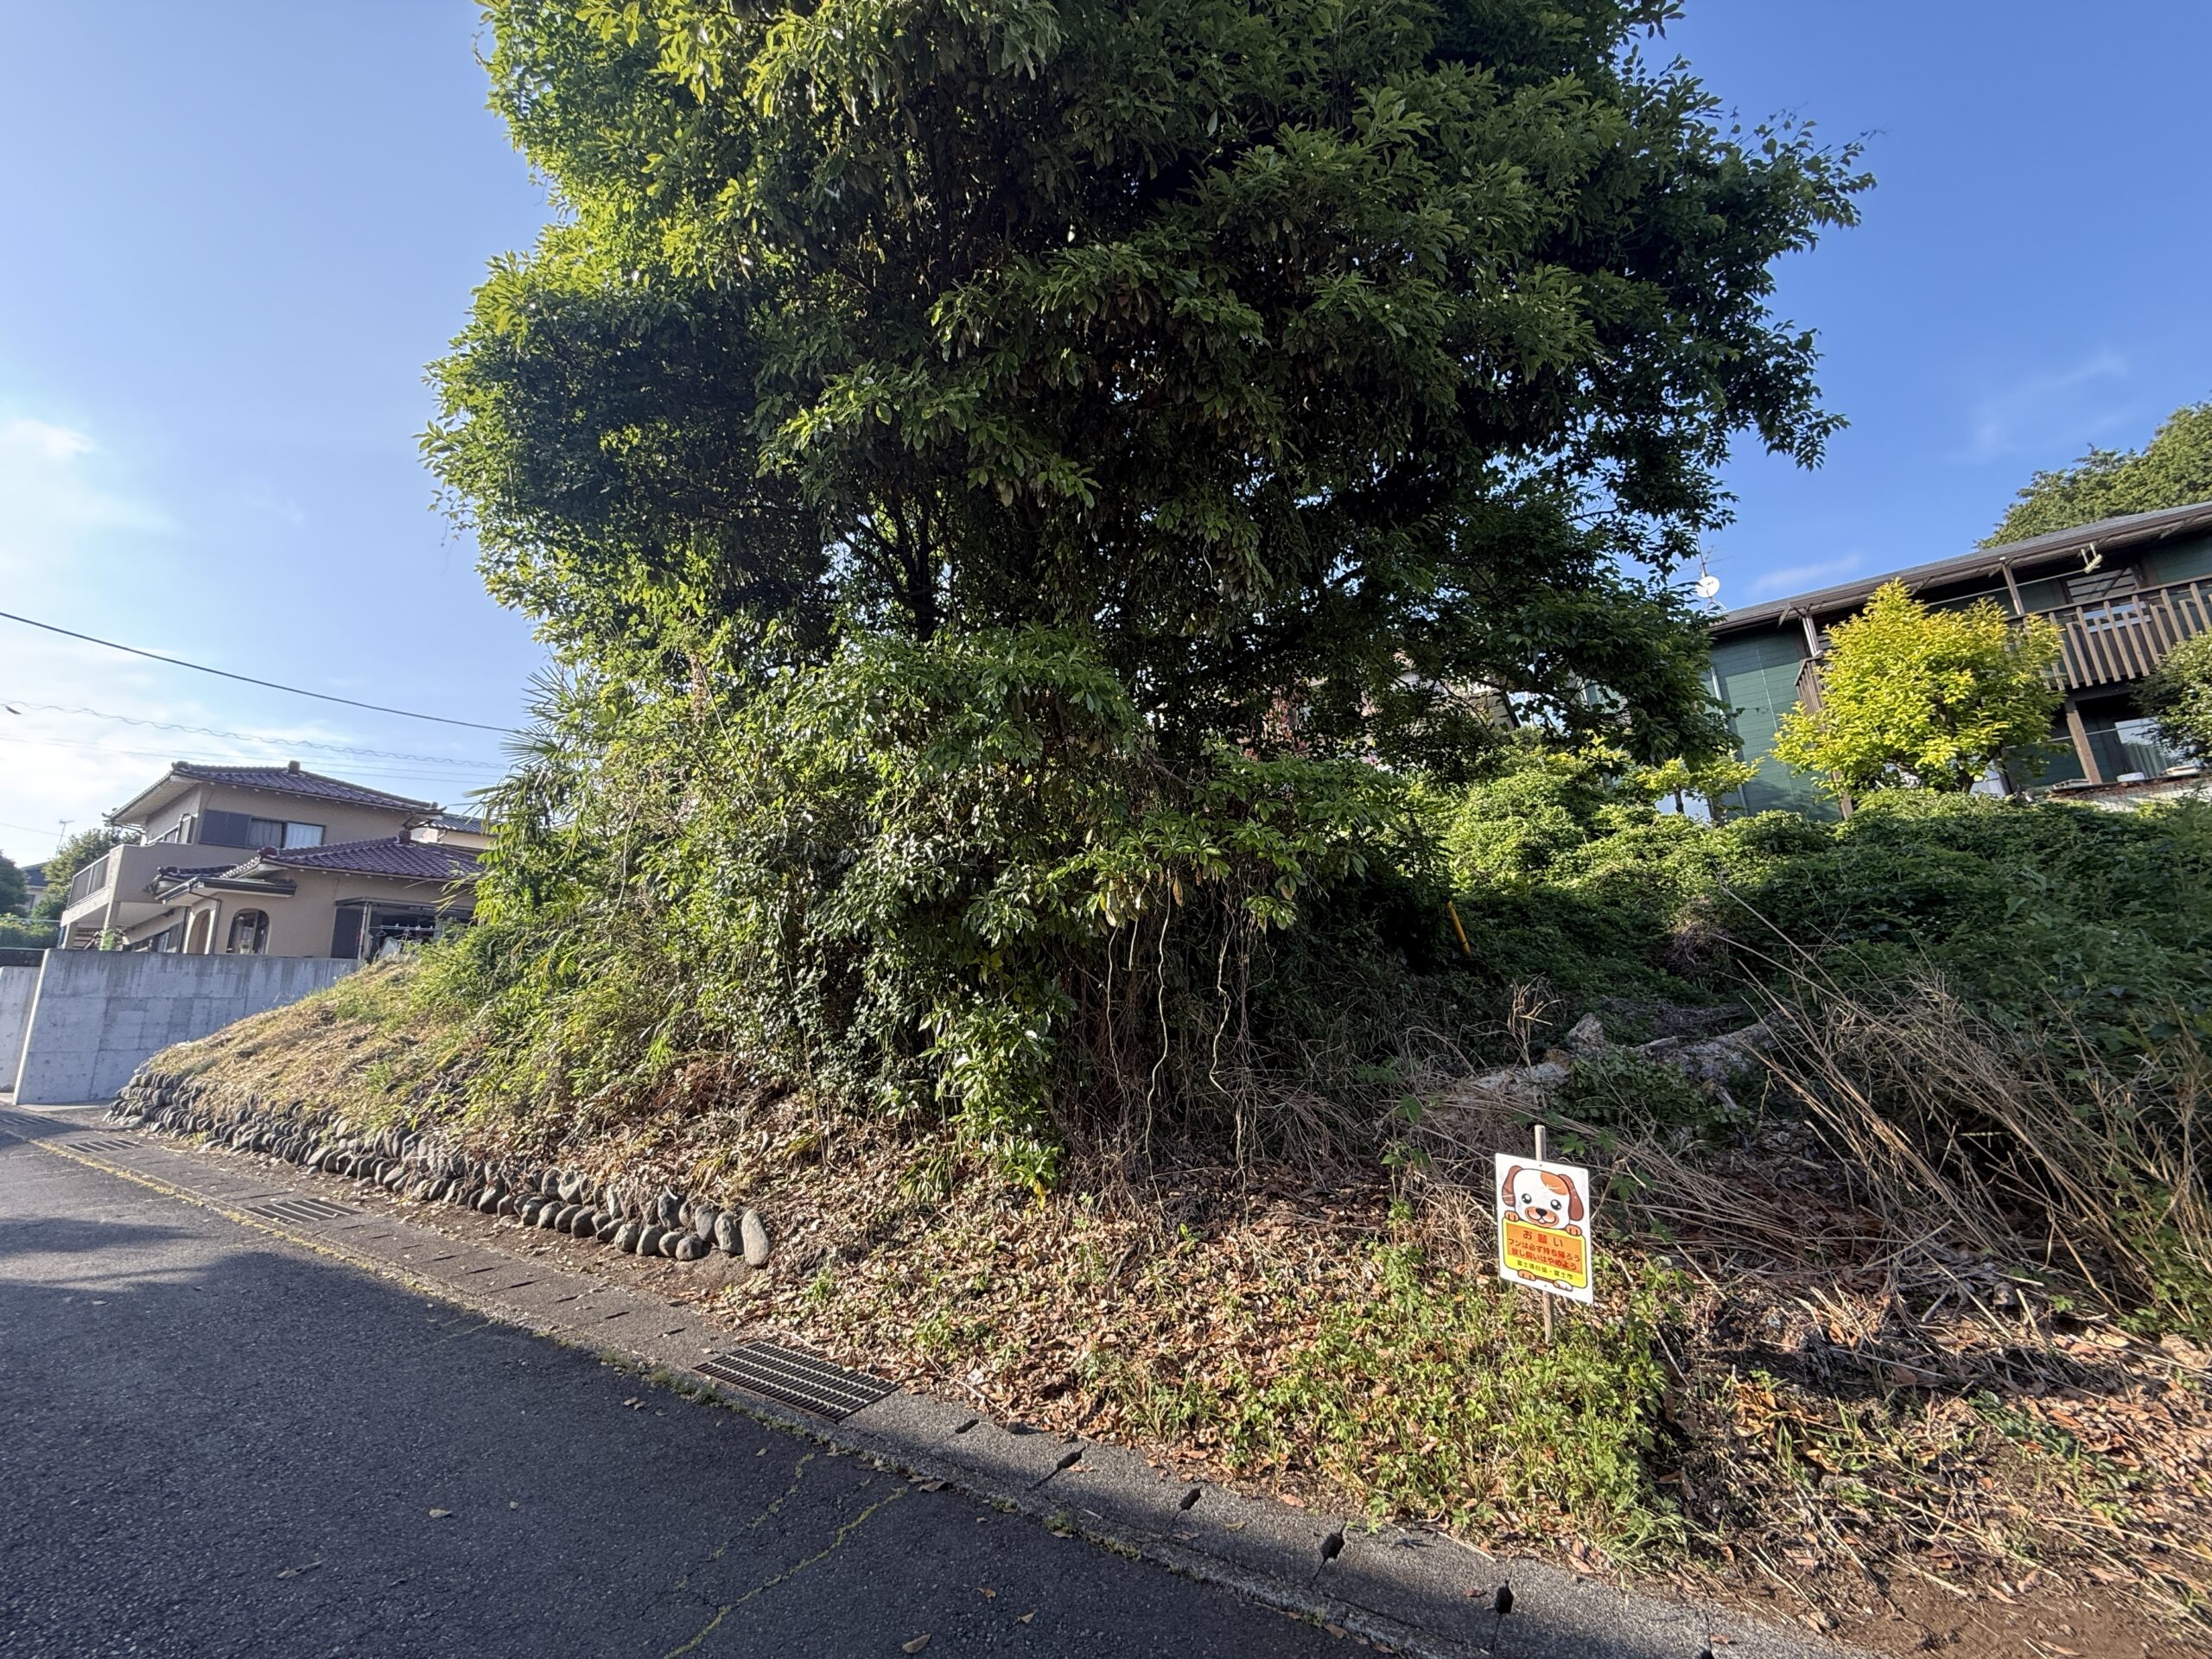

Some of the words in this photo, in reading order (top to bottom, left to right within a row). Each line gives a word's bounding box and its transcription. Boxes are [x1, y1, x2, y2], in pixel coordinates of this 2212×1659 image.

[1508, 1238, 1580, 1262] フンは必ず持ち帰ろう
